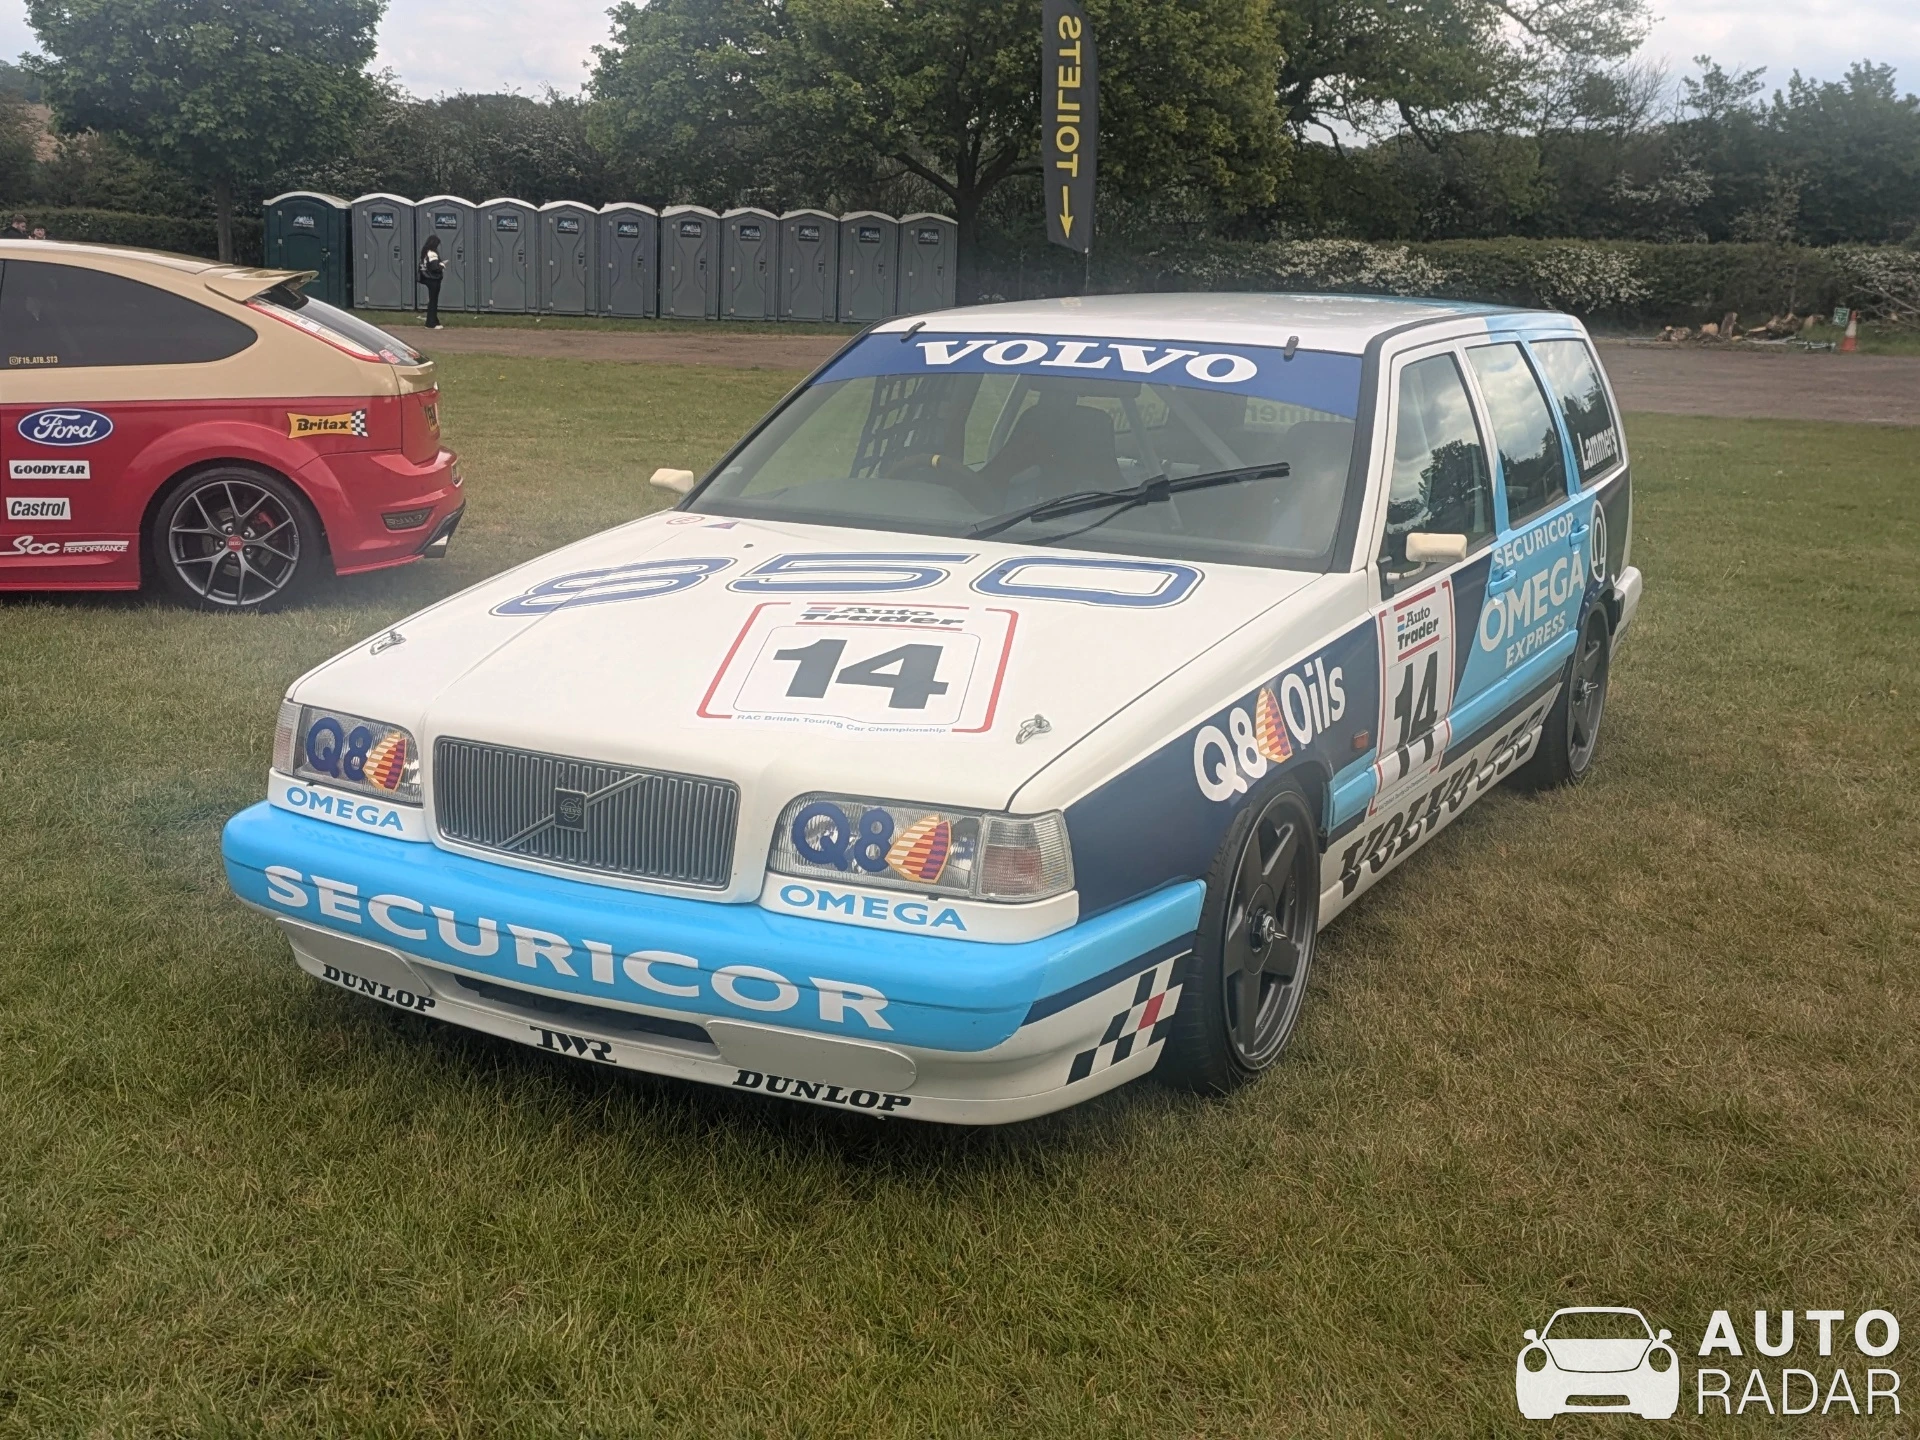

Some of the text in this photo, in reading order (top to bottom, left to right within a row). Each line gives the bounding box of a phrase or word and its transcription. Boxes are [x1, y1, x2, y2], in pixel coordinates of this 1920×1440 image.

[915, 339, 1258, 383] VOLVO
[33, 413, 98, 439] Ford
[296, 418, 349, 431] Britax
[13, 465, 86, 474] GOODYEAR
[1577, 426, 1619, 470] Lammers
[10, 501, 66, 516] Castrol
[63, 544, 128, 553] PERFORMANCE
[1494, 512, 1574, 567] SECURICOR
[488, 551, 1206, 617] 850
[1480, 552, 1585, 652] OMEGA
[800, 613, 966, 626] Trader
[834, 607, 935, 616] Auto
[1397, 617, 1440, 650] Trader
[1405, 606, 1431, 629] Auto
[1506, 610, 1567, 669] EXPRESS
[773, 638, 949, 710] 14
[764, 714, 799, 723] British
[803, 717, 843, 729] Touring
[846, 724, 865, 732] Car
[868, 726, 947, 734] Championship
[1193, 657, 1346, 801] Q8 Oils
[1393, 651, 1438, 780] 14
[305, 716, 373, 781] Q8
[286, 786, 404, 831] OMEGA
[1339, 756, 1477, 899] VOLVO
[792, 801, 895, 872] Q8
[779, 884, 968, 932] OMEGA
[264, 865, 894, 1031] SECURICOR
[323, 964, 436, 1013] DUNLOP
[529, 1026, 617, 1064] TWR
[733, 1069, 912, 1112] DUNLOP
